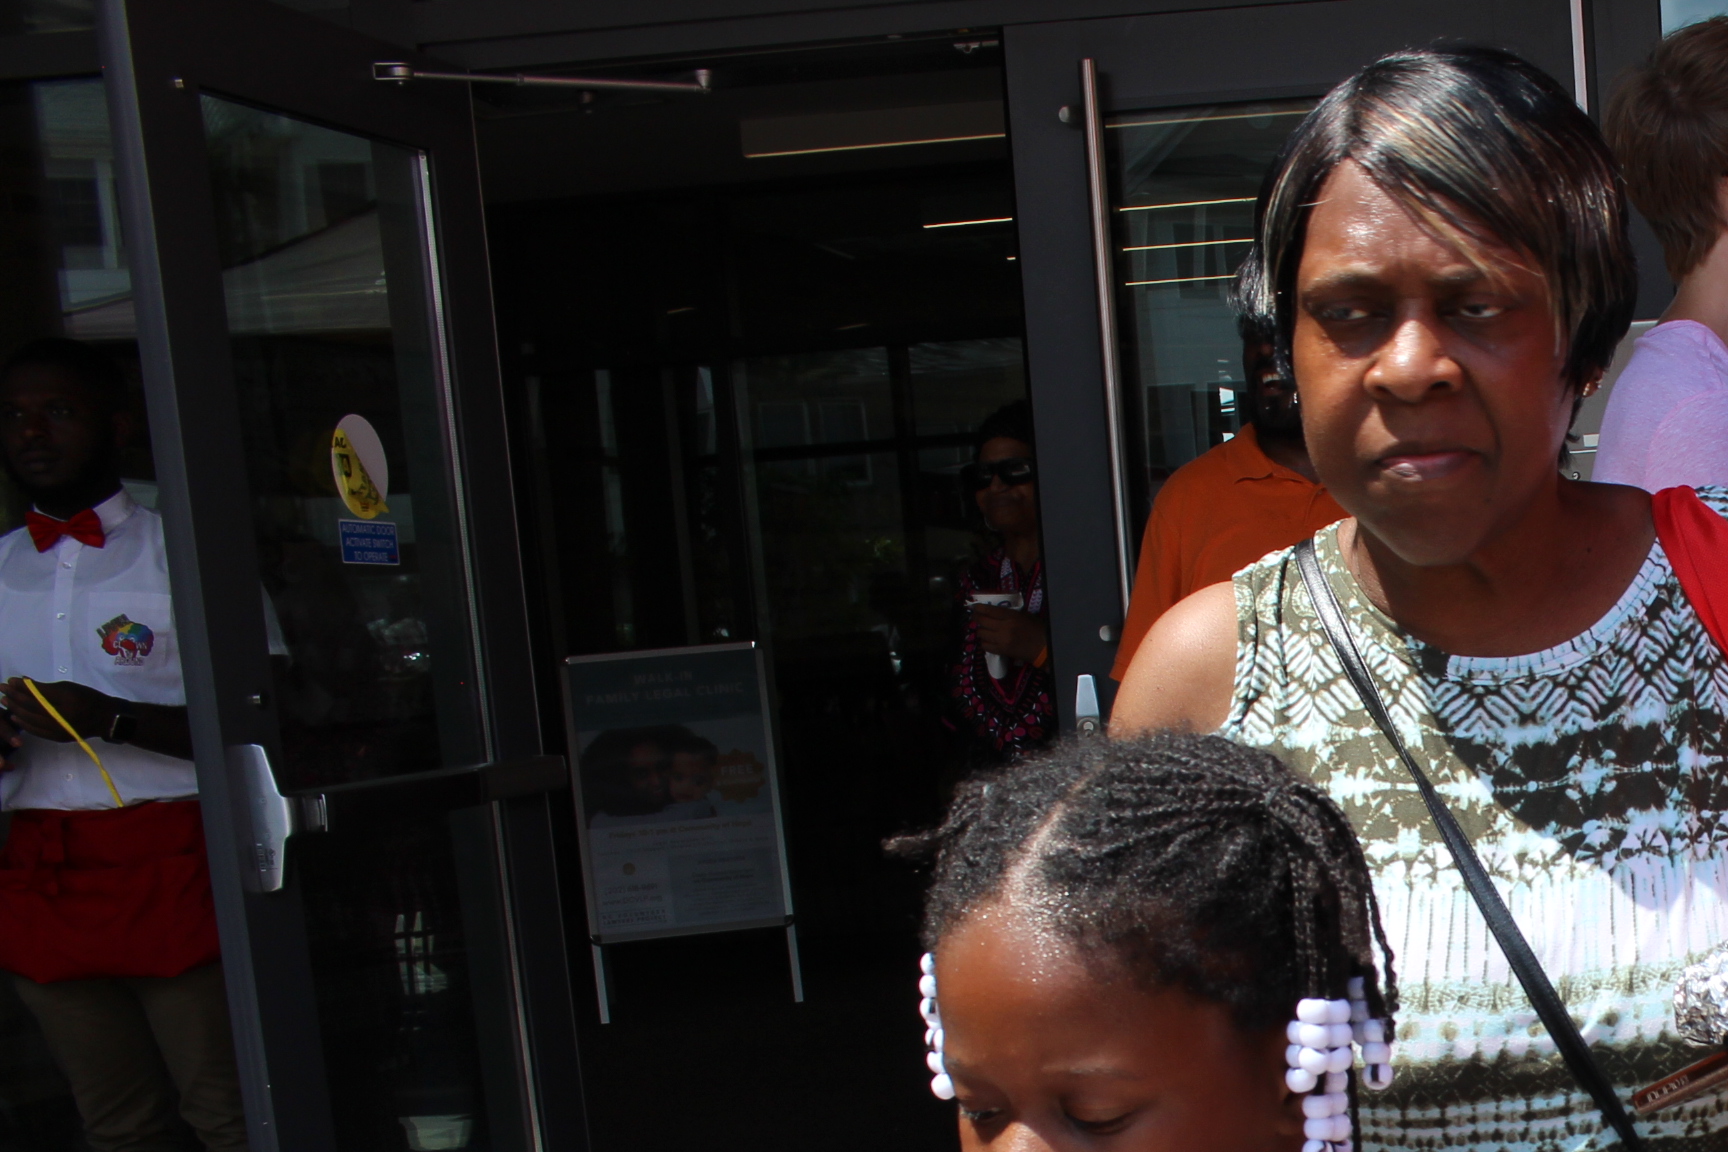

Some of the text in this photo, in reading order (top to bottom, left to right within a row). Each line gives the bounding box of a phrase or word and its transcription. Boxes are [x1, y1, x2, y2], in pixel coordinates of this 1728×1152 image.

[342, 523, 394, 536] AUTOMATIC DOOR
[345, 537, 394, 549] ACTIVATE SWITCH
[354, 550, 389, 562] TO OPERATE
[633, 670, 693, 685] WALK-IN
[586, 682, 744, 705] FAMILY LEGAL CLINIC
[720, 763, 753, 776] FREE
